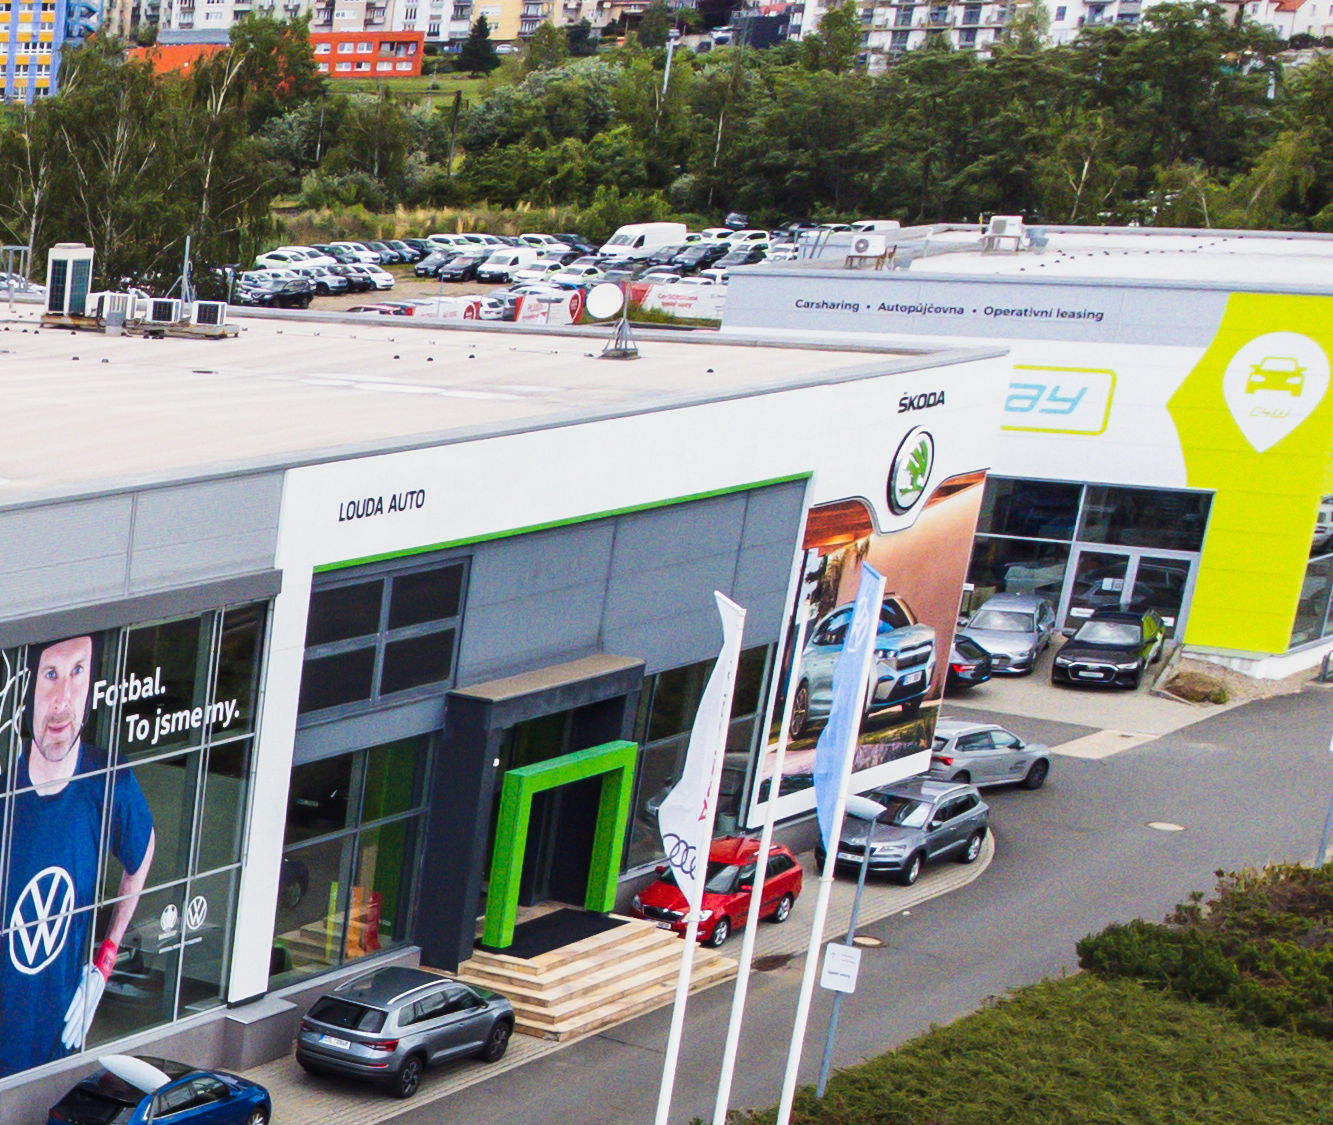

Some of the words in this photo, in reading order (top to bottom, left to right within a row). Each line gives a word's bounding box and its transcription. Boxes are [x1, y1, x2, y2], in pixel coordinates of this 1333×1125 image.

[794, 297, 860, 312] Carsharing
[877, 301, 965, 317] Autopůjčovna
[983, 305, 1054, 318] Operativní
[1055, 307, 1105, 322] leasing
[897, 390, 946, 414] ŠKODA
[338, 496, 384, 522] LOUDA
[387, 488, 426, 514] AUTO
[92, 666, 166, 710] Fotbal.
[126, 713, 150, 742] To
[151, 706, 203, 746] jsme
